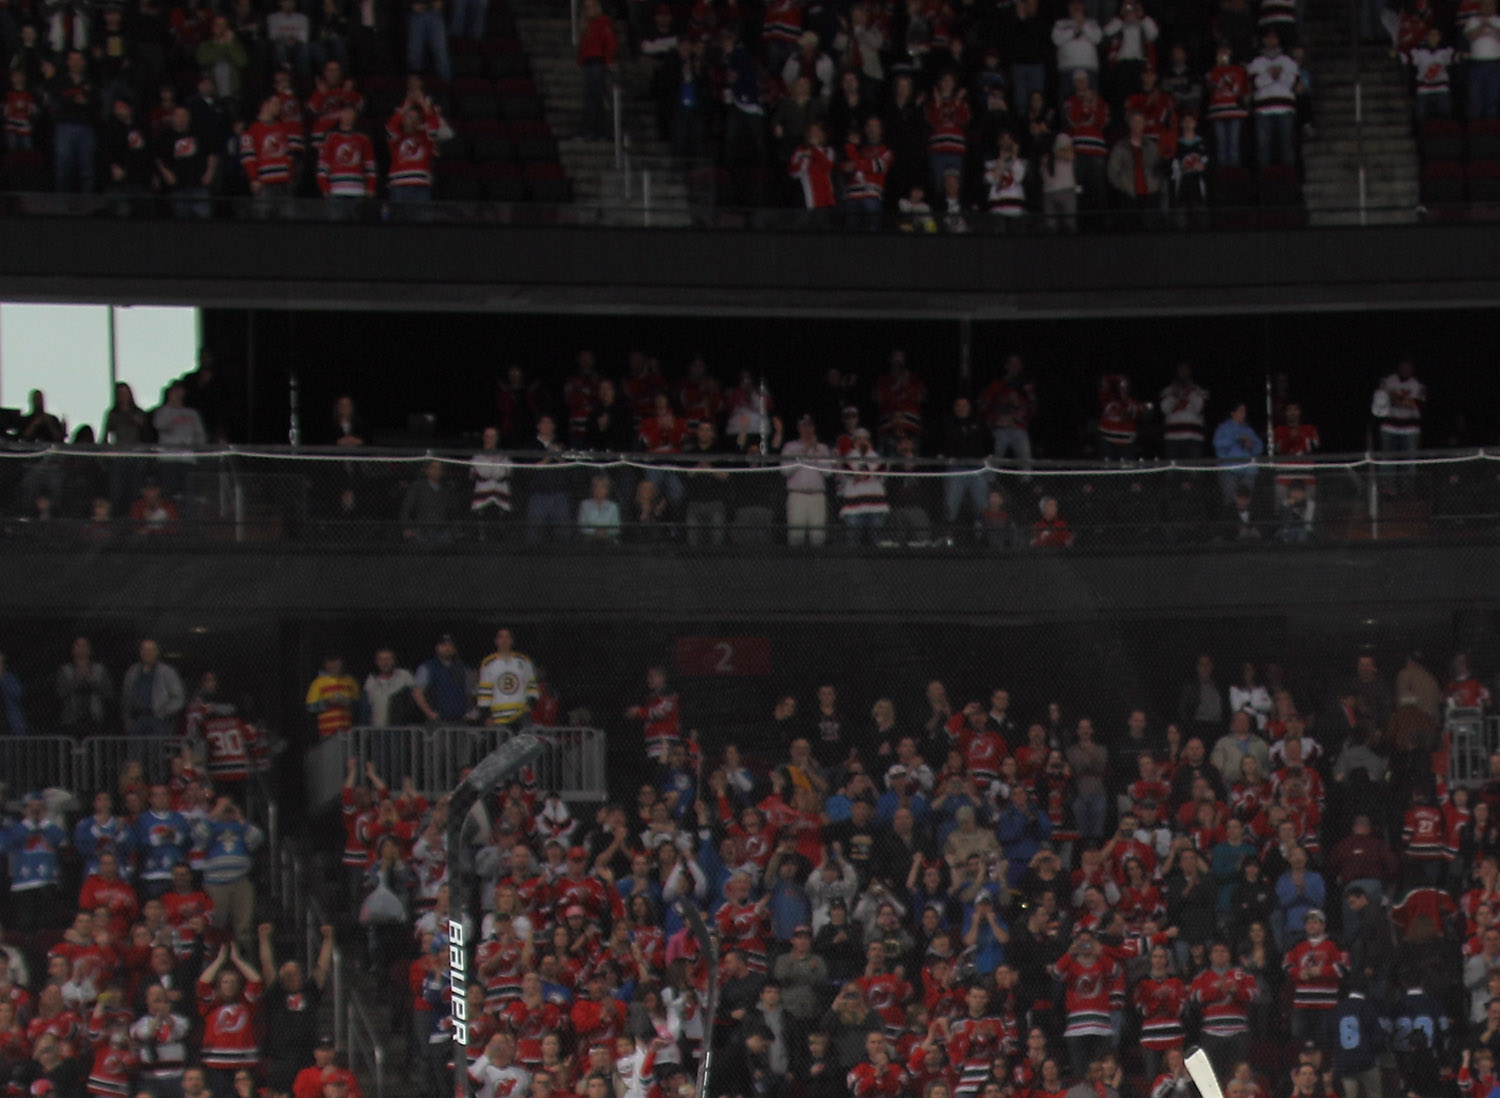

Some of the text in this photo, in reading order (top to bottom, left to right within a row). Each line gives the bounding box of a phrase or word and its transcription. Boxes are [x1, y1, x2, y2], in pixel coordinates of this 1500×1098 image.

[713, 642, 732, 671] 2
[206, 730, 243, 755] 30
[449, 919, 467, 1045] BAUER
[1340, 1015, 1360, 1050] 8
